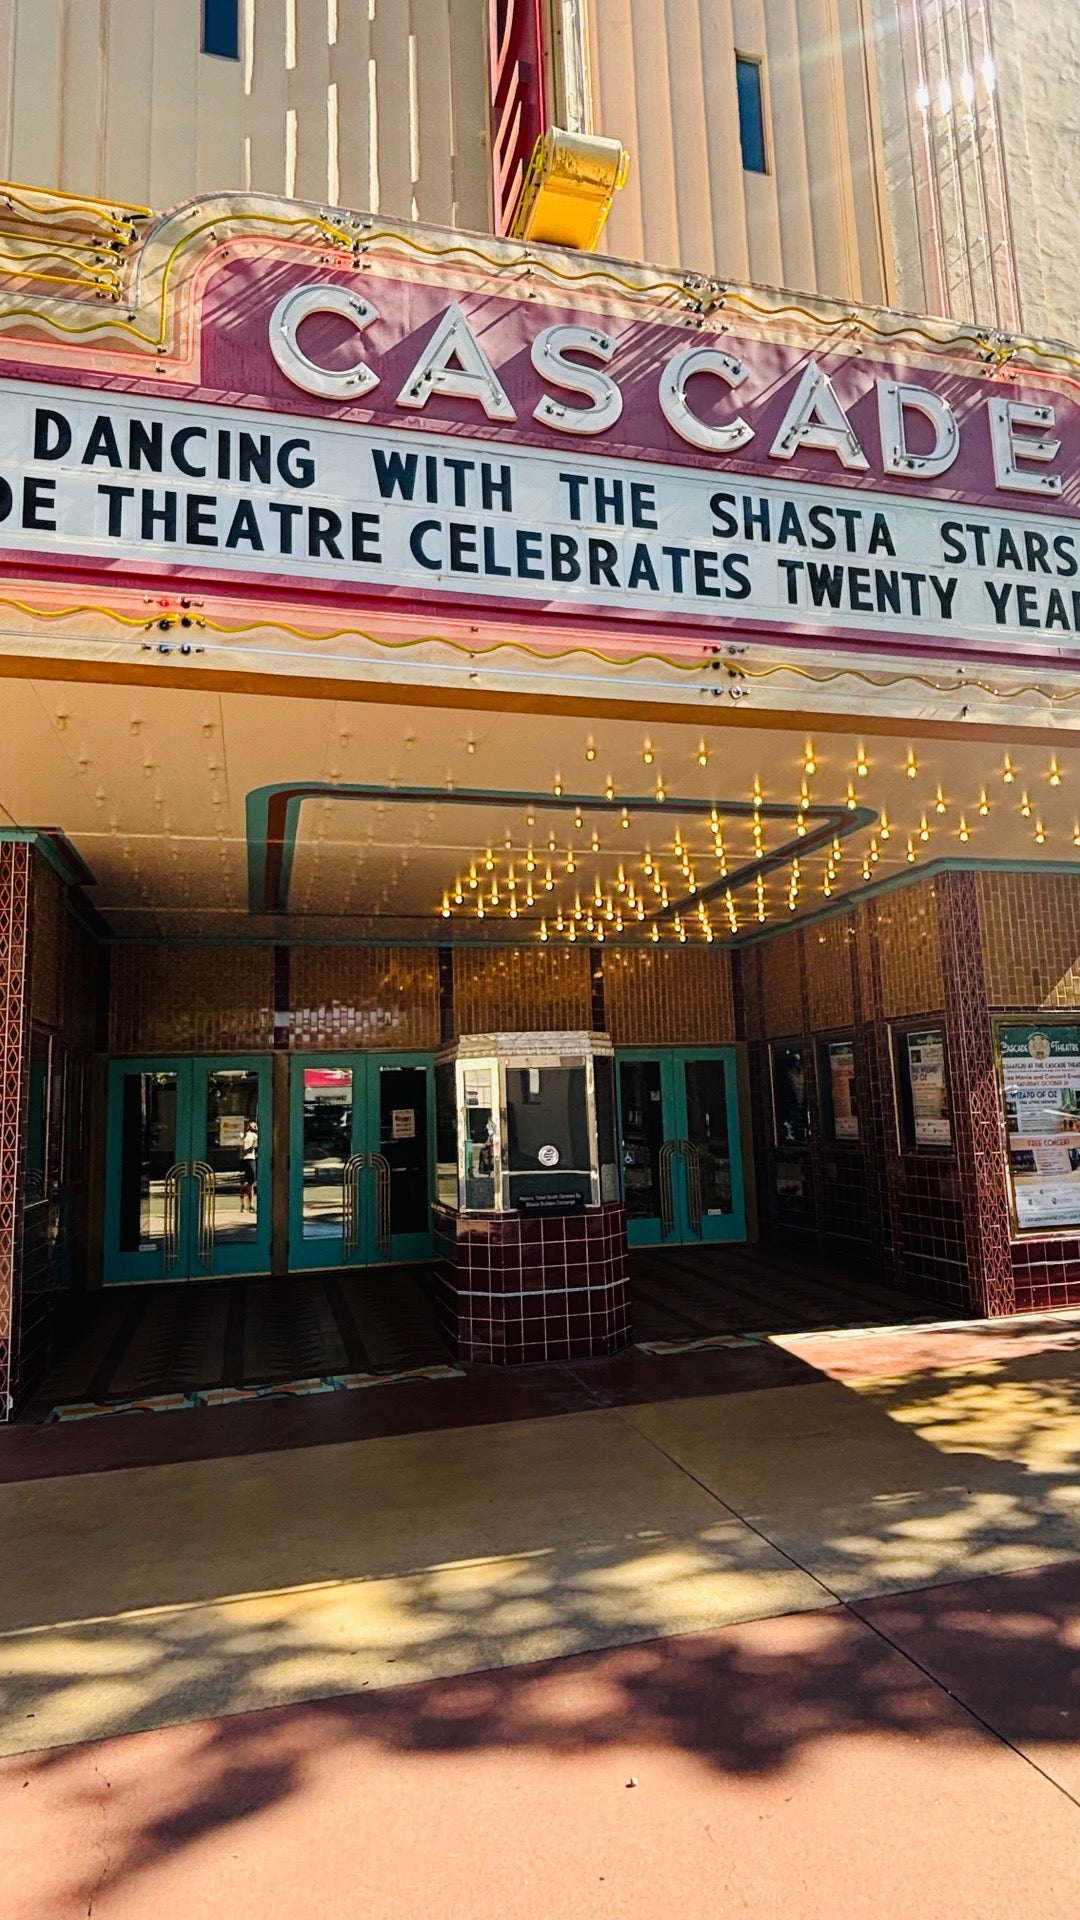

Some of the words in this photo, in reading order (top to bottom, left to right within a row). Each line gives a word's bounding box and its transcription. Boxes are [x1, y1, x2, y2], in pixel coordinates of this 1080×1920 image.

[268, 284, 1063, 496] CASCADE
[34, 408, 315, 488] DANCING
[372, 449, 512, 512] WITH
[559, 473, 658, 529] THE
[709, 493, 896, 556] SHASTA
[940, 521, 1078, 577] STARS
[97, 484, 382, 563] THEATRE
[410, 520, 752, 600] CELEBRATES
[777, 559, 958, 619] TWENTY
[1027, 1139, 1041, 1147] FREE
[1043, 1138, 1070, 1146] CONCERT
[1048, 1090, 1058, 1098] OZ
